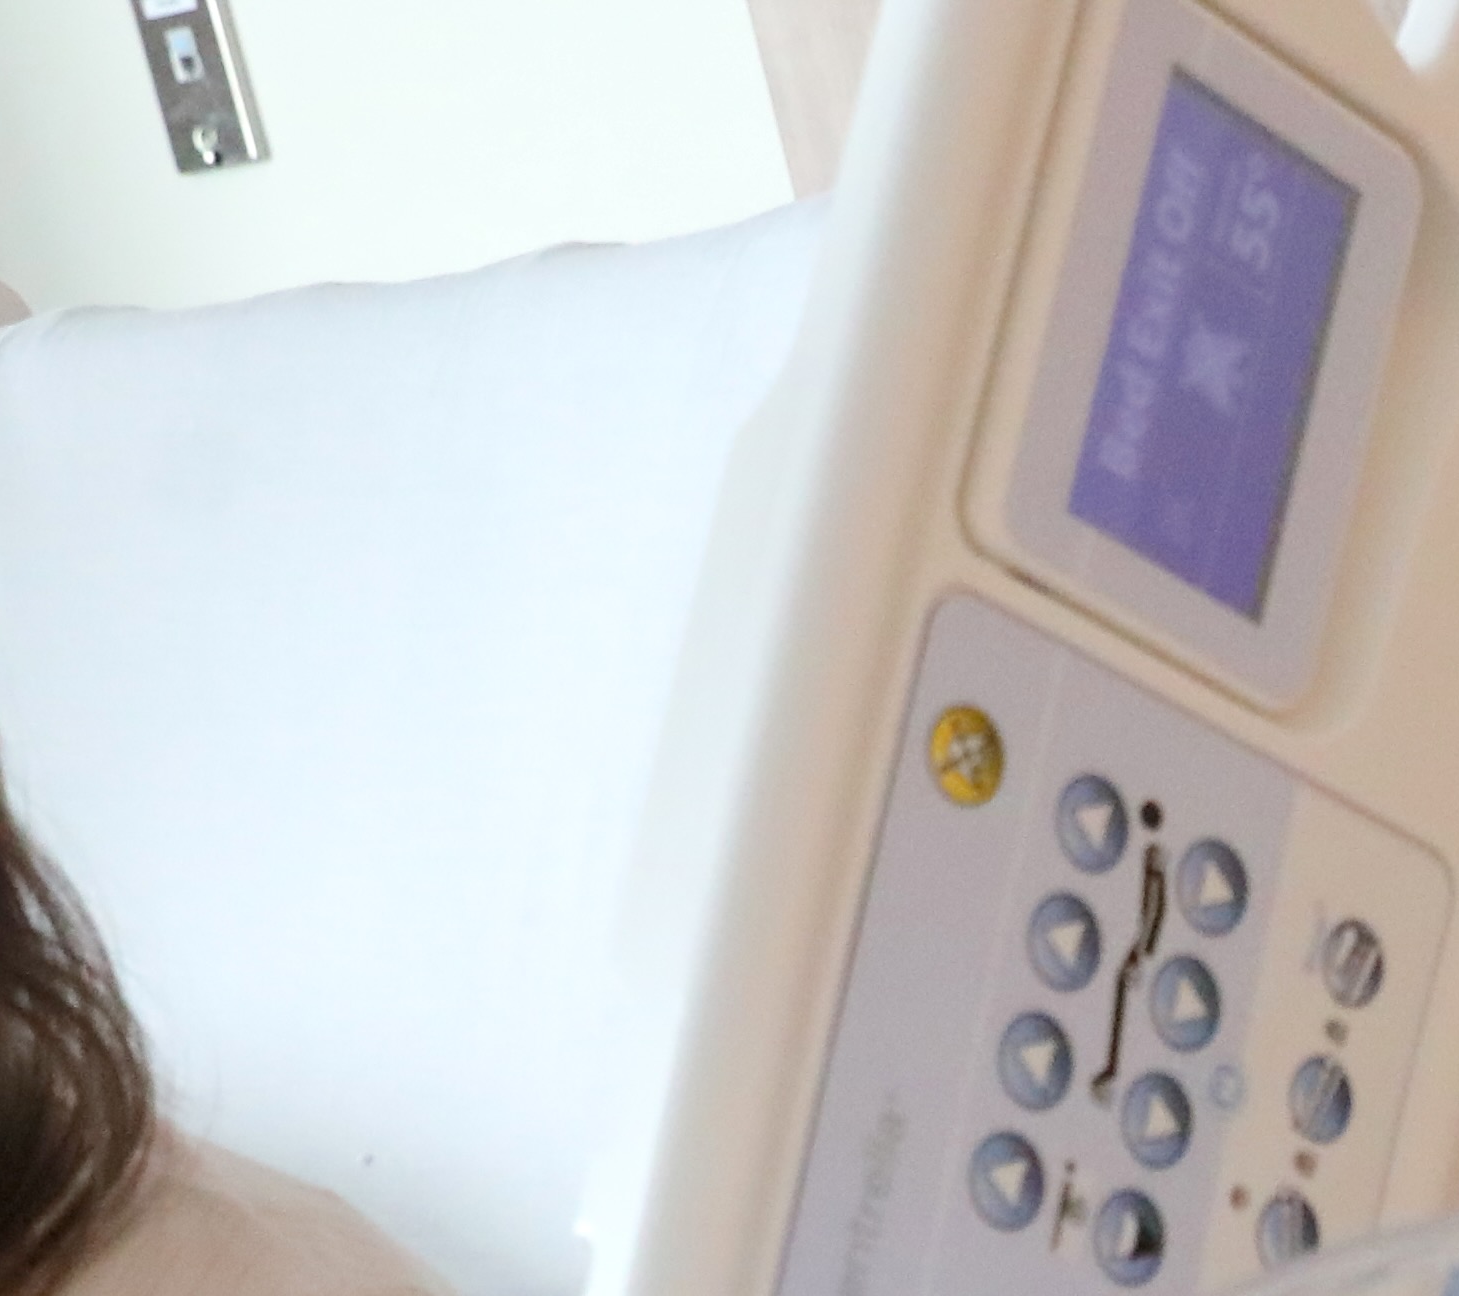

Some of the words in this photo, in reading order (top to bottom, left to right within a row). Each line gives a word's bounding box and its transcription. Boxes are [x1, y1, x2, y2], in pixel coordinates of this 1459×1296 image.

[1152, 144, 1206, 242] Off
[1127, 246, 1184, 362] Exit
[1098, 362, 1158, 481] Bed
